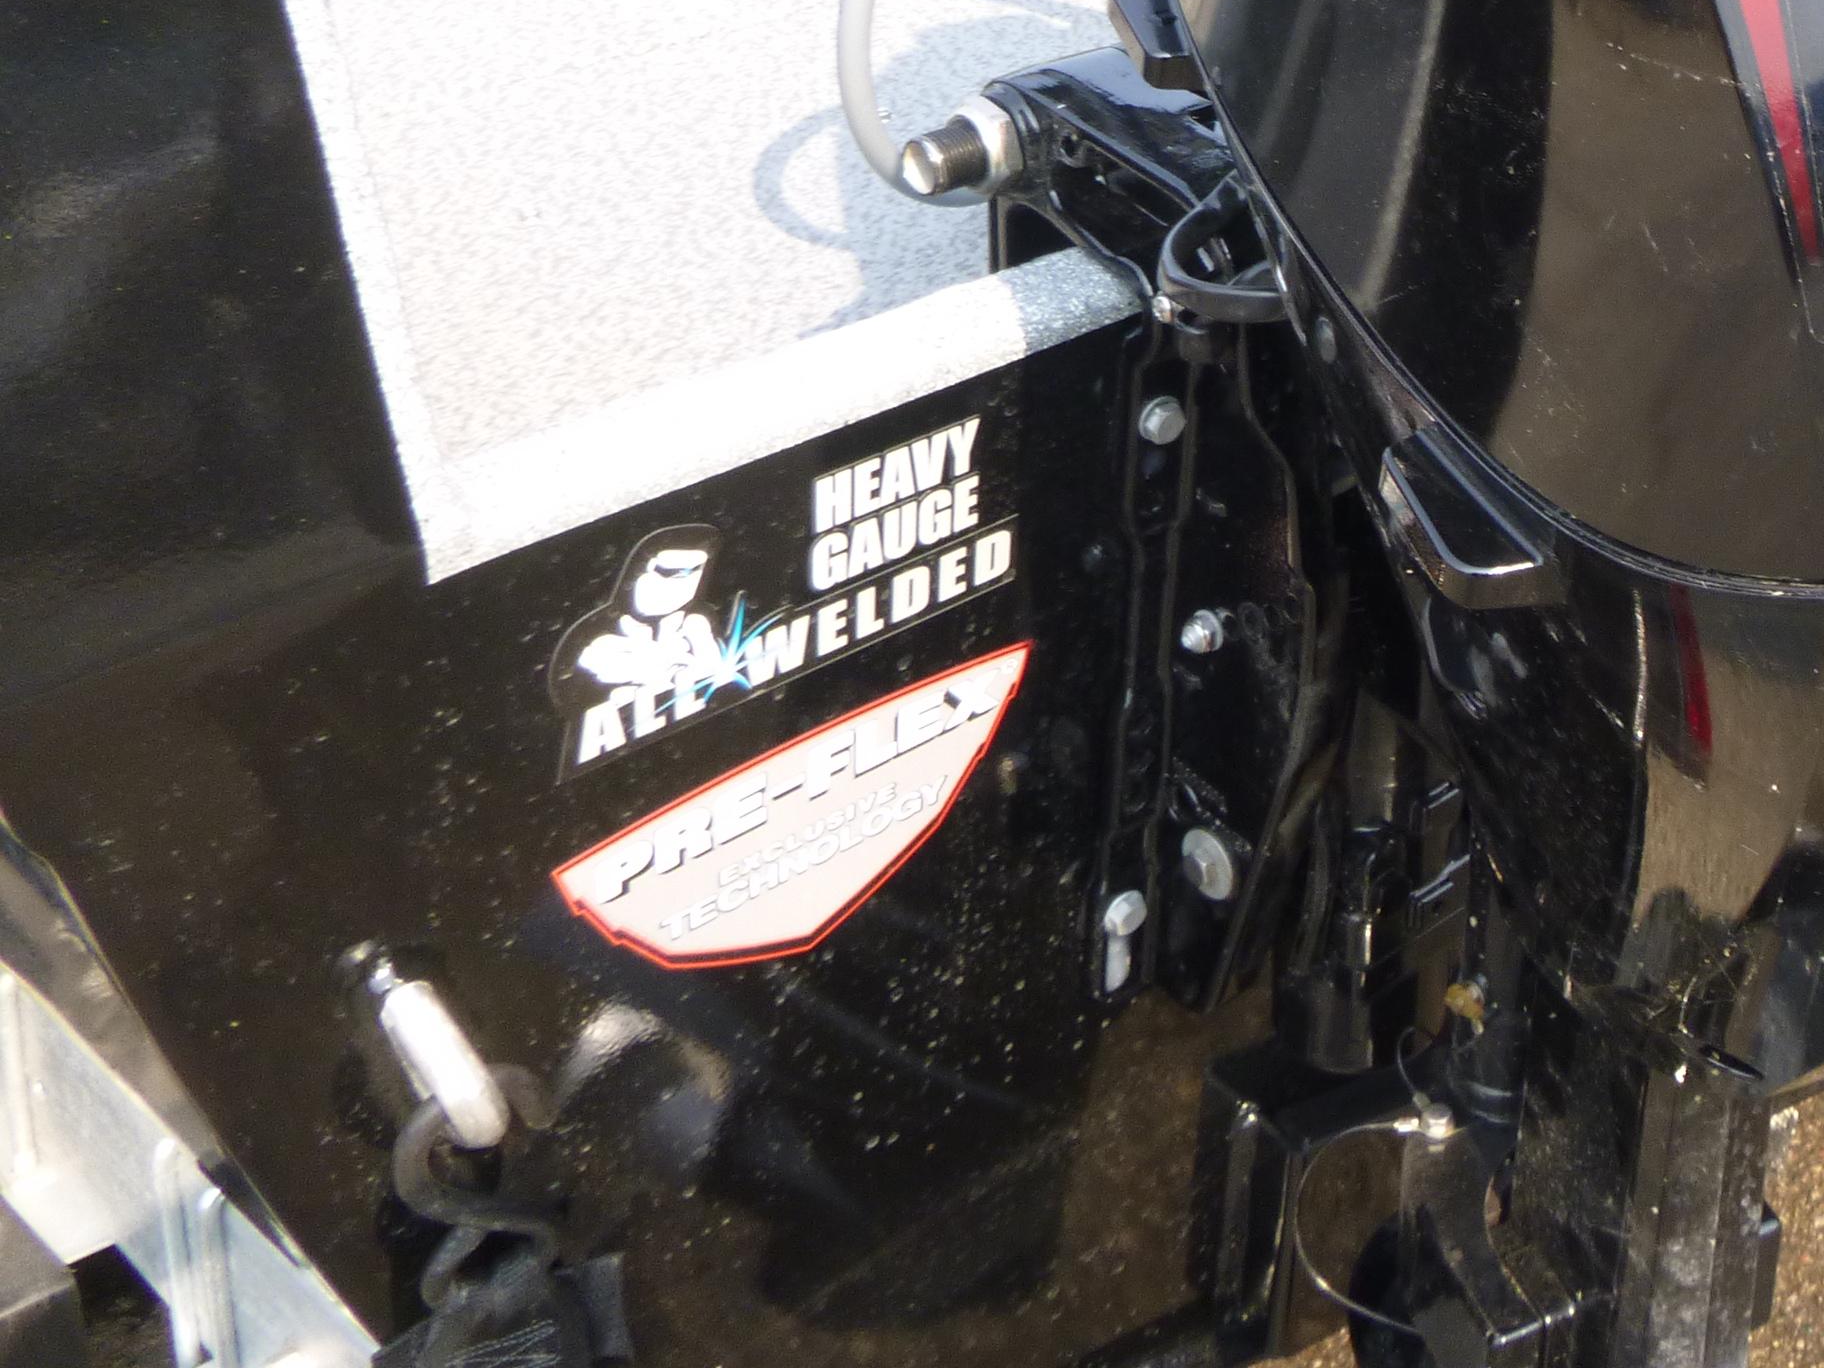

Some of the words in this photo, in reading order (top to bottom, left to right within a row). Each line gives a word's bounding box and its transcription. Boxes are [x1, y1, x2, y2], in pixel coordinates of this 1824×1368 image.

[809, 475, 981, 592] GAUGE
[814, 417, 981, 534] HEAVY
[577, 668, 706, 764] ALL
[745, 529, 1013, 689] WELDED
[597, 668, 999, 905] PRE-FLEX
[718, 782, 898, 887] EXCLUSIVE
[659, 775, 948, 941] TECHNOLOGY
